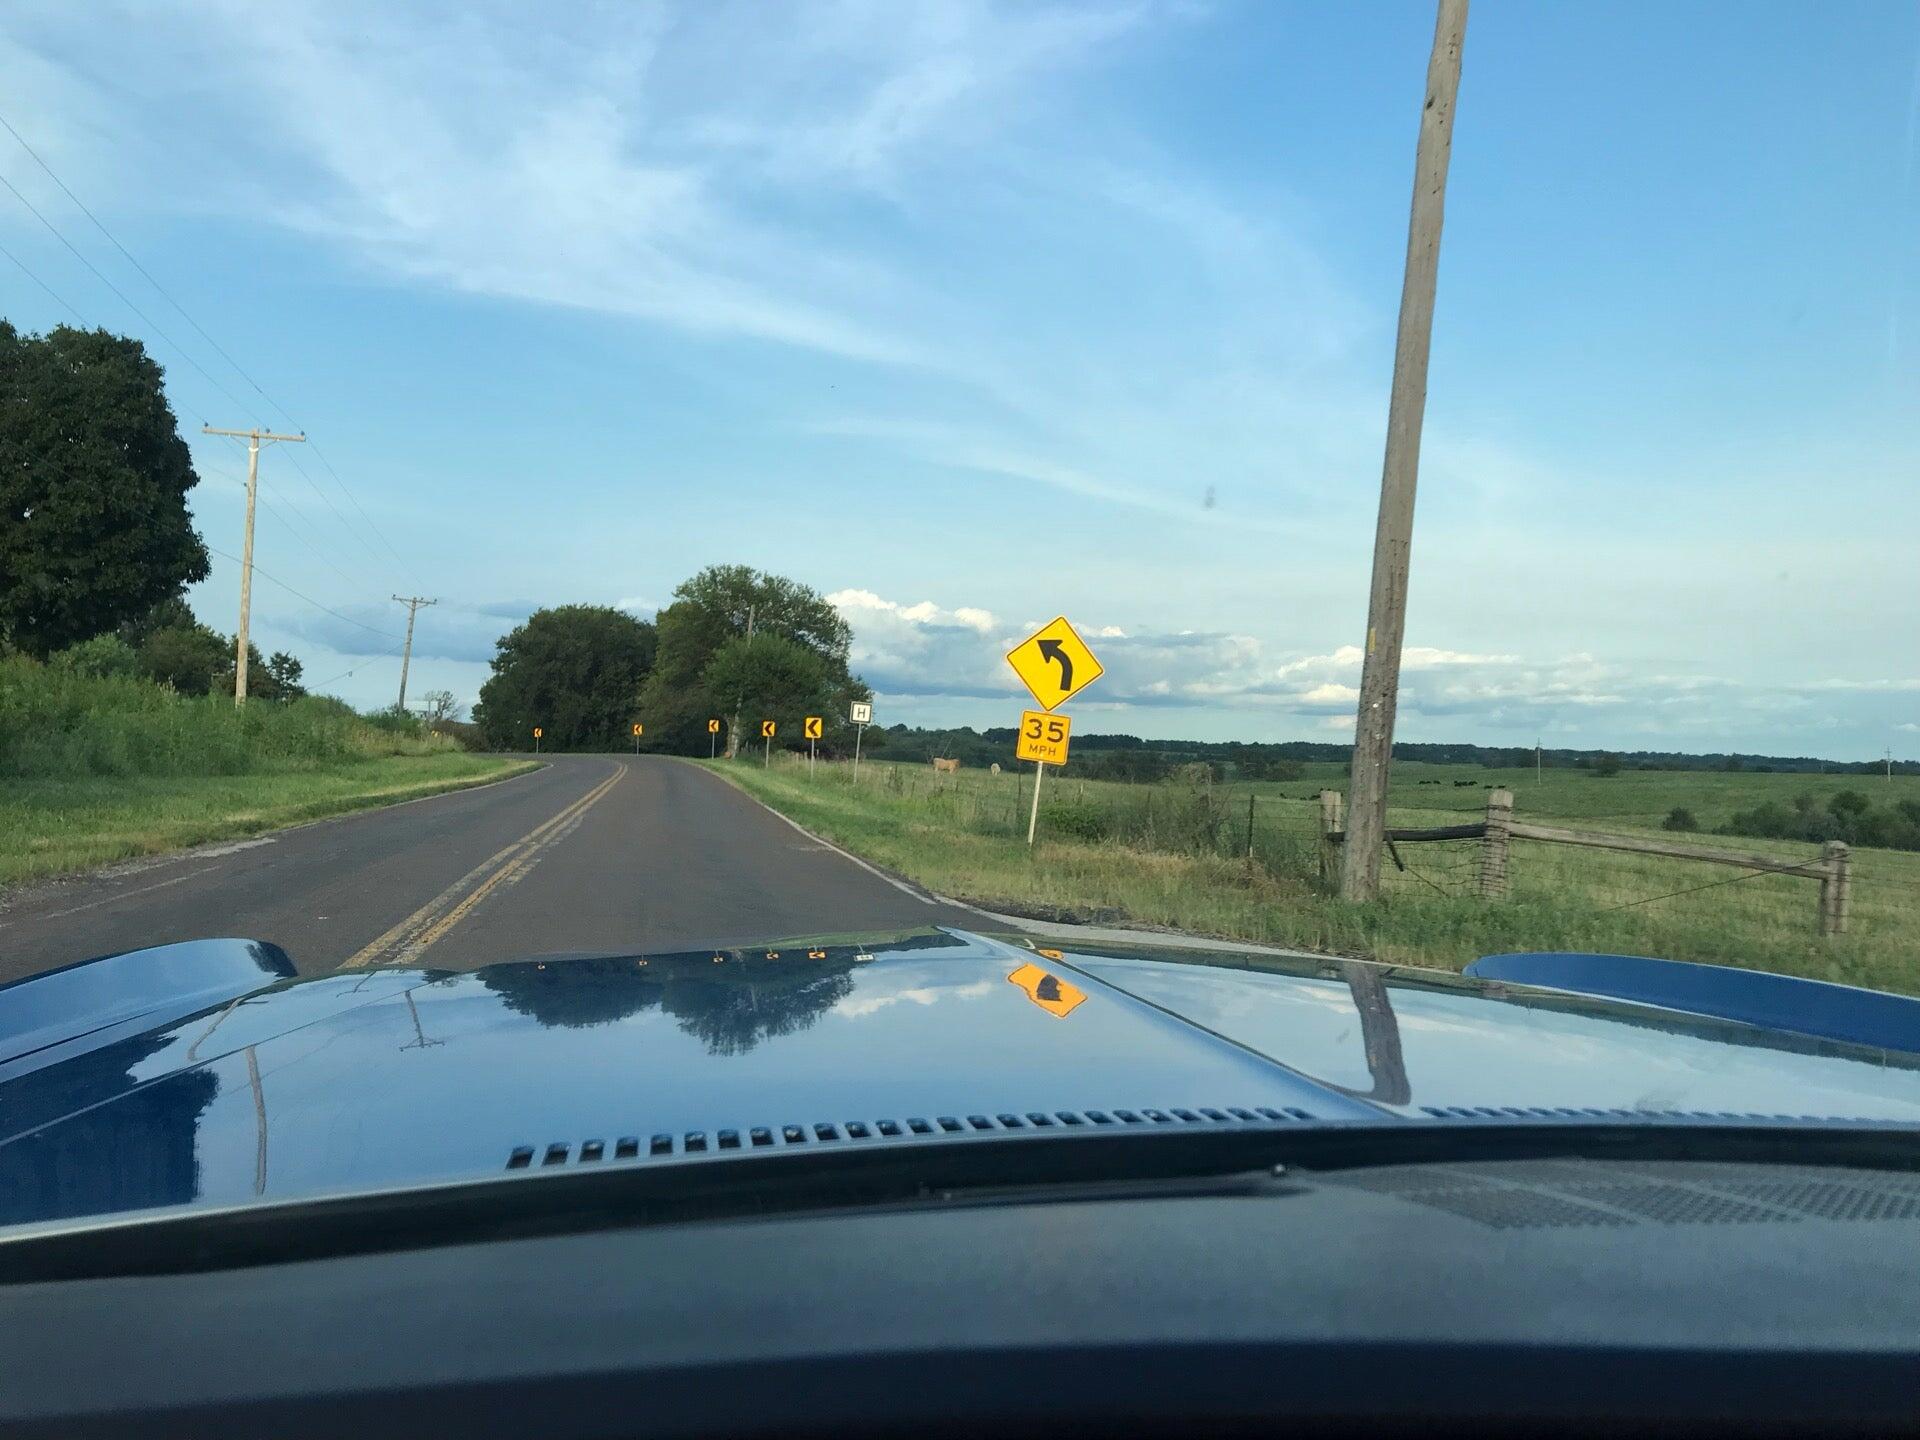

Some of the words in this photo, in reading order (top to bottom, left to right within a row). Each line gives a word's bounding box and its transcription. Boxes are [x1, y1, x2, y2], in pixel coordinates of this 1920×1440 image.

[857, 707, 866, 718] H
[1025, 718, 1064, 743] 35
[1028, 744, 1057, 756] MPH
